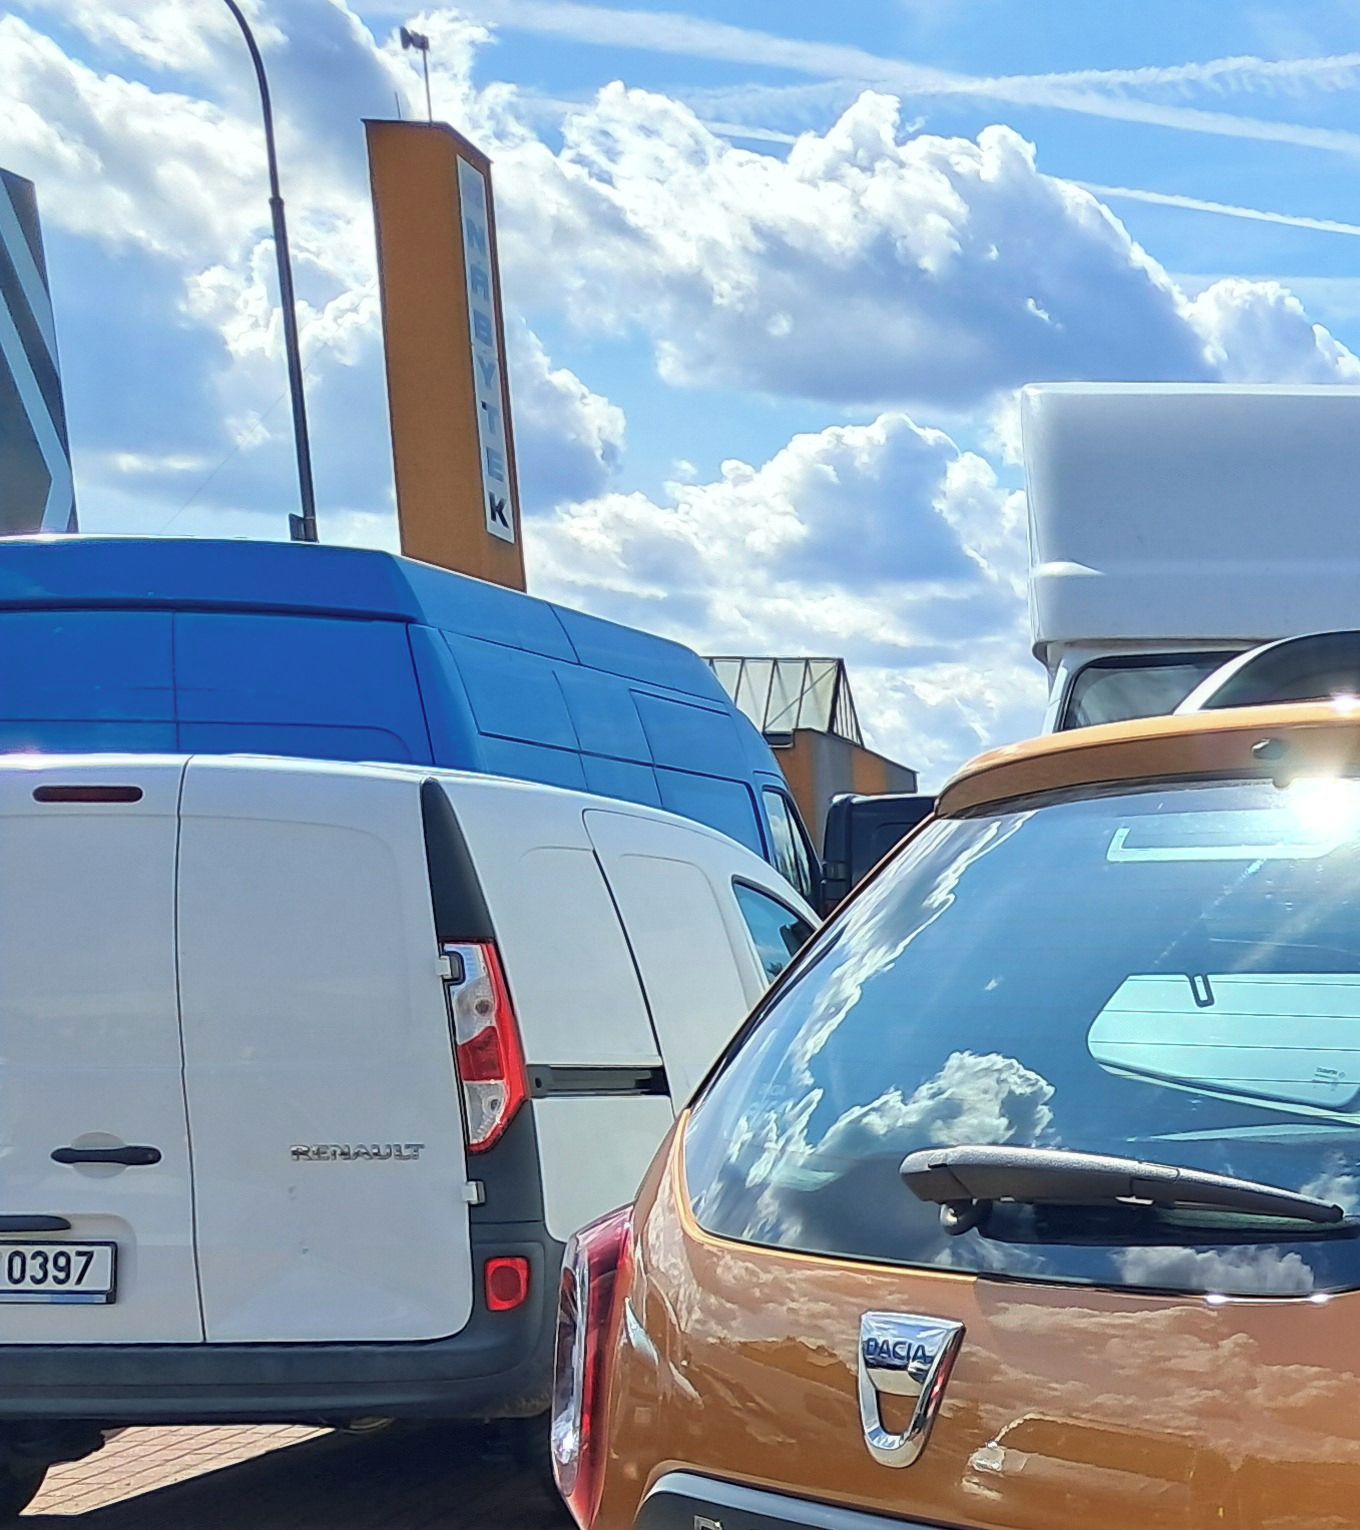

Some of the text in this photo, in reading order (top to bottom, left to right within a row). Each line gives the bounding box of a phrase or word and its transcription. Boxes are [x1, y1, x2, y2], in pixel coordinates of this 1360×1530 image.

[290, 1143, 425, 1161] RENAULT
[7, 1250, 95, 1285] 0397
[865, 1337, 929, 1364] DACIA
